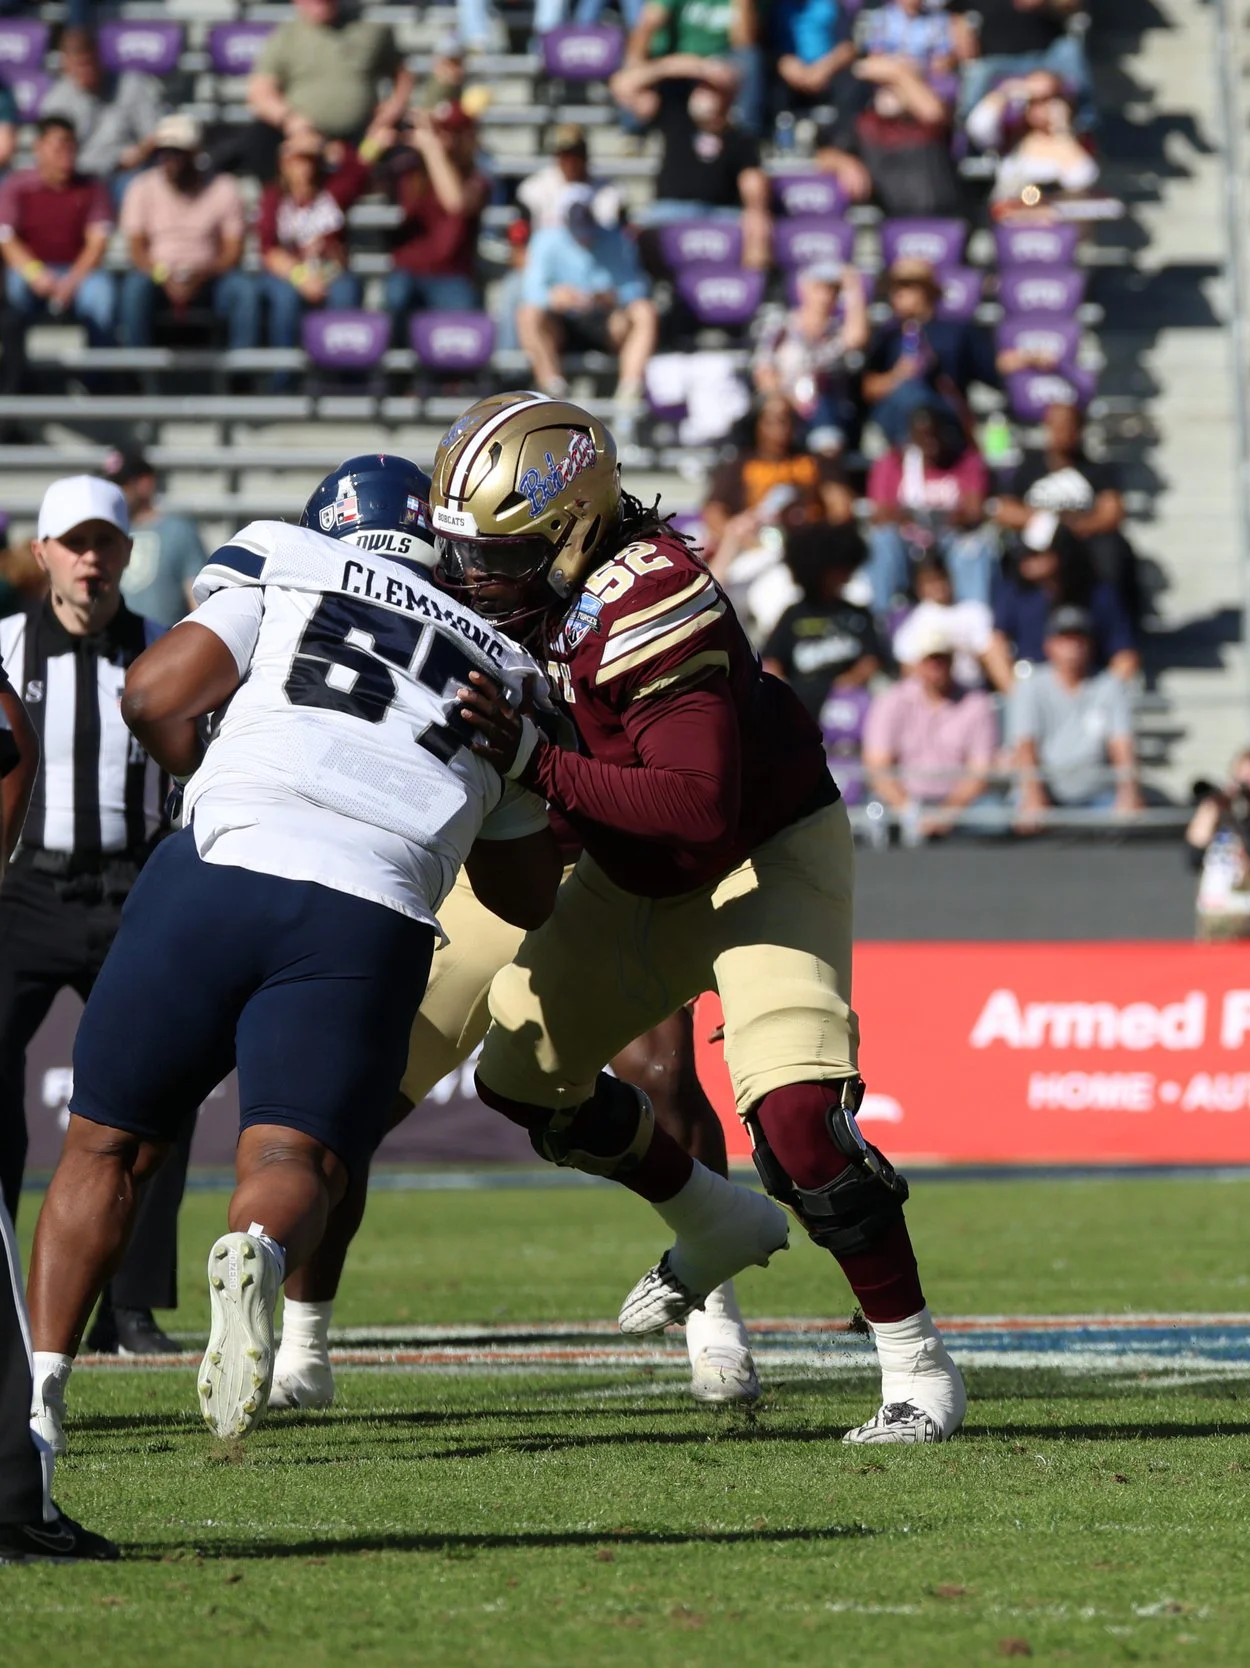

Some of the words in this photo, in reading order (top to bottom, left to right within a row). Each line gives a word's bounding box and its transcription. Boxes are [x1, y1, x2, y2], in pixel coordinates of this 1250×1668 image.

[437, 511, 466, 528] BOBCATS
[584, 540, 675, 604] 52
[969, 988, 1208, 1050] Armed
[1027, 1072, 1156, 1111] HOME
